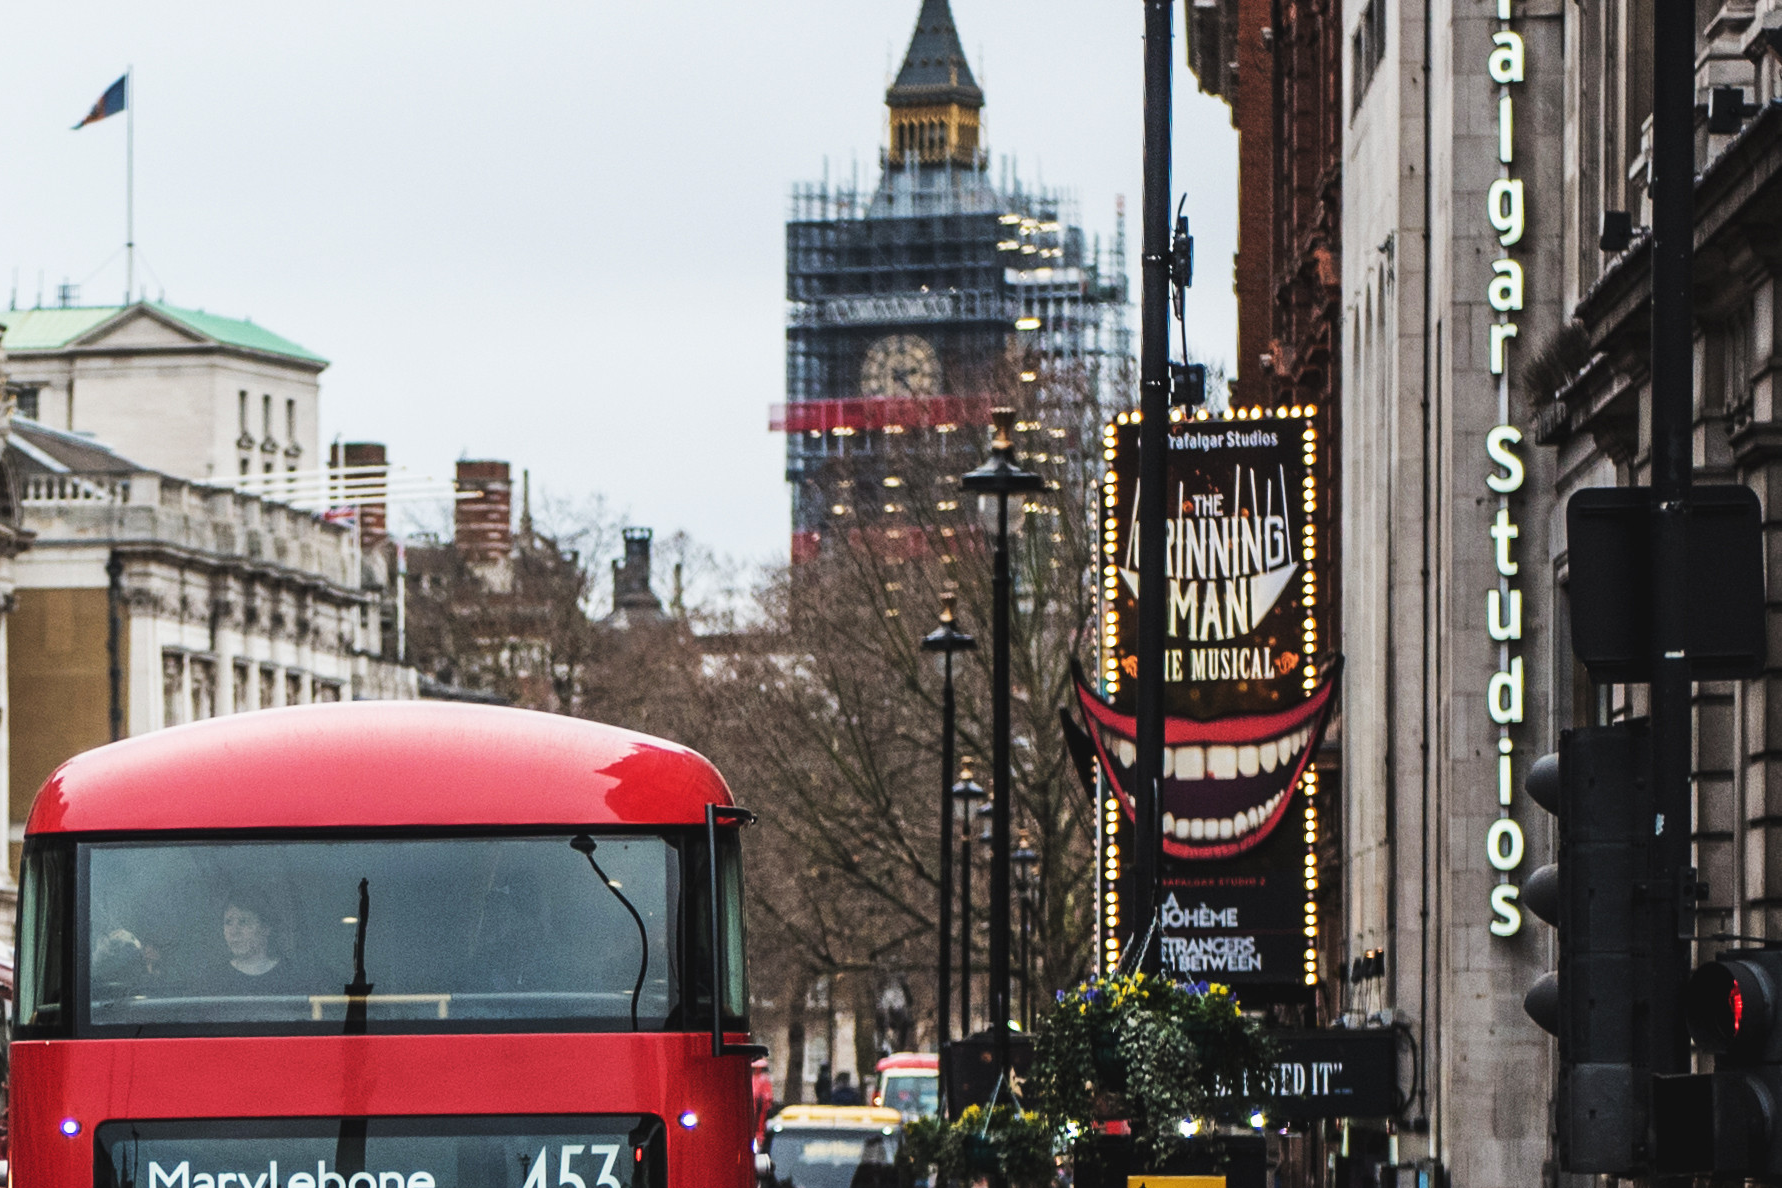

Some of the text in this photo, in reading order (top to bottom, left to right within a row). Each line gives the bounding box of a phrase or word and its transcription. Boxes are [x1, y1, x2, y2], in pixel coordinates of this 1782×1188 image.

[1168, 429, 1279, 452] rafalgar Studios
[1192, 494, 1224, 517] THE
[1168, 576, 1250, 641] MAN
[1191, 647, 1275, 681] MUSICAL
[1486, 425, 1525, 938] Studios
[1178, 952, 1262, 972] BETWEEN
